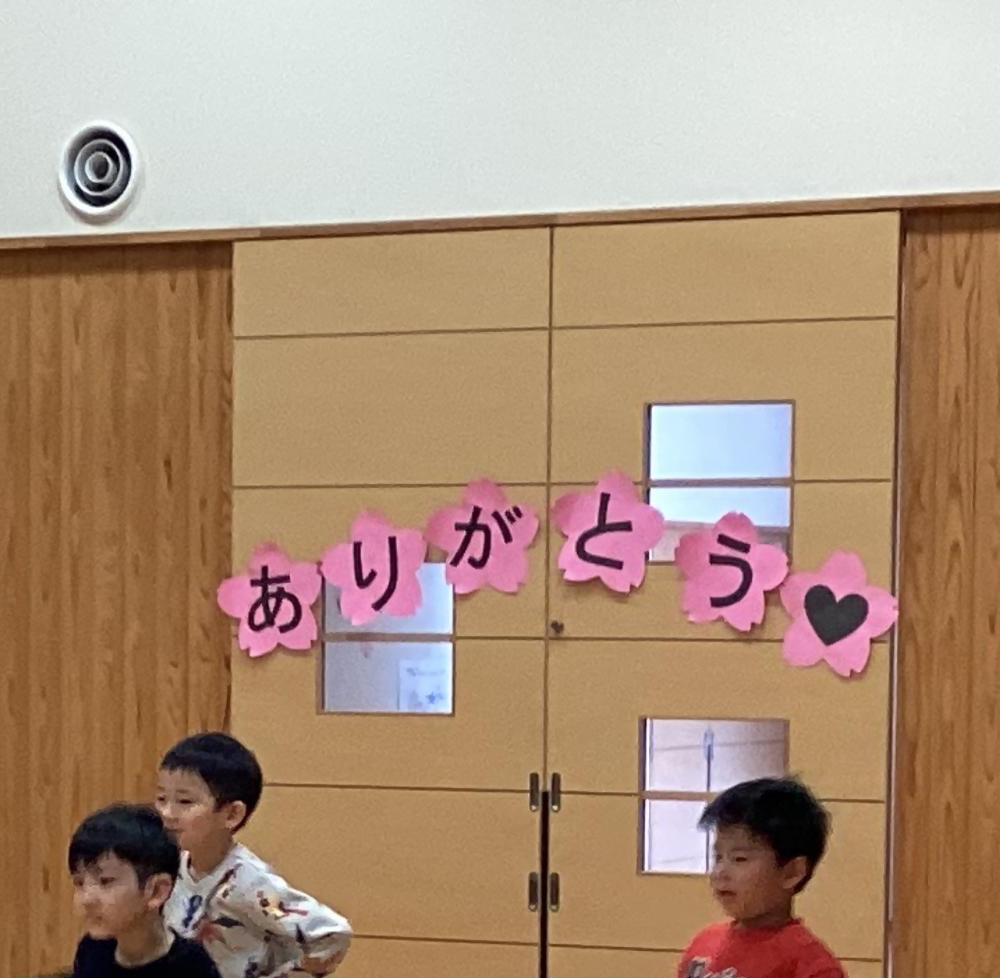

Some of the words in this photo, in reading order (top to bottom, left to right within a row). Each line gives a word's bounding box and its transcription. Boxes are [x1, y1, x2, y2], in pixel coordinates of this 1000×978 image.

[246, 491, 753, 634] ありがとう
